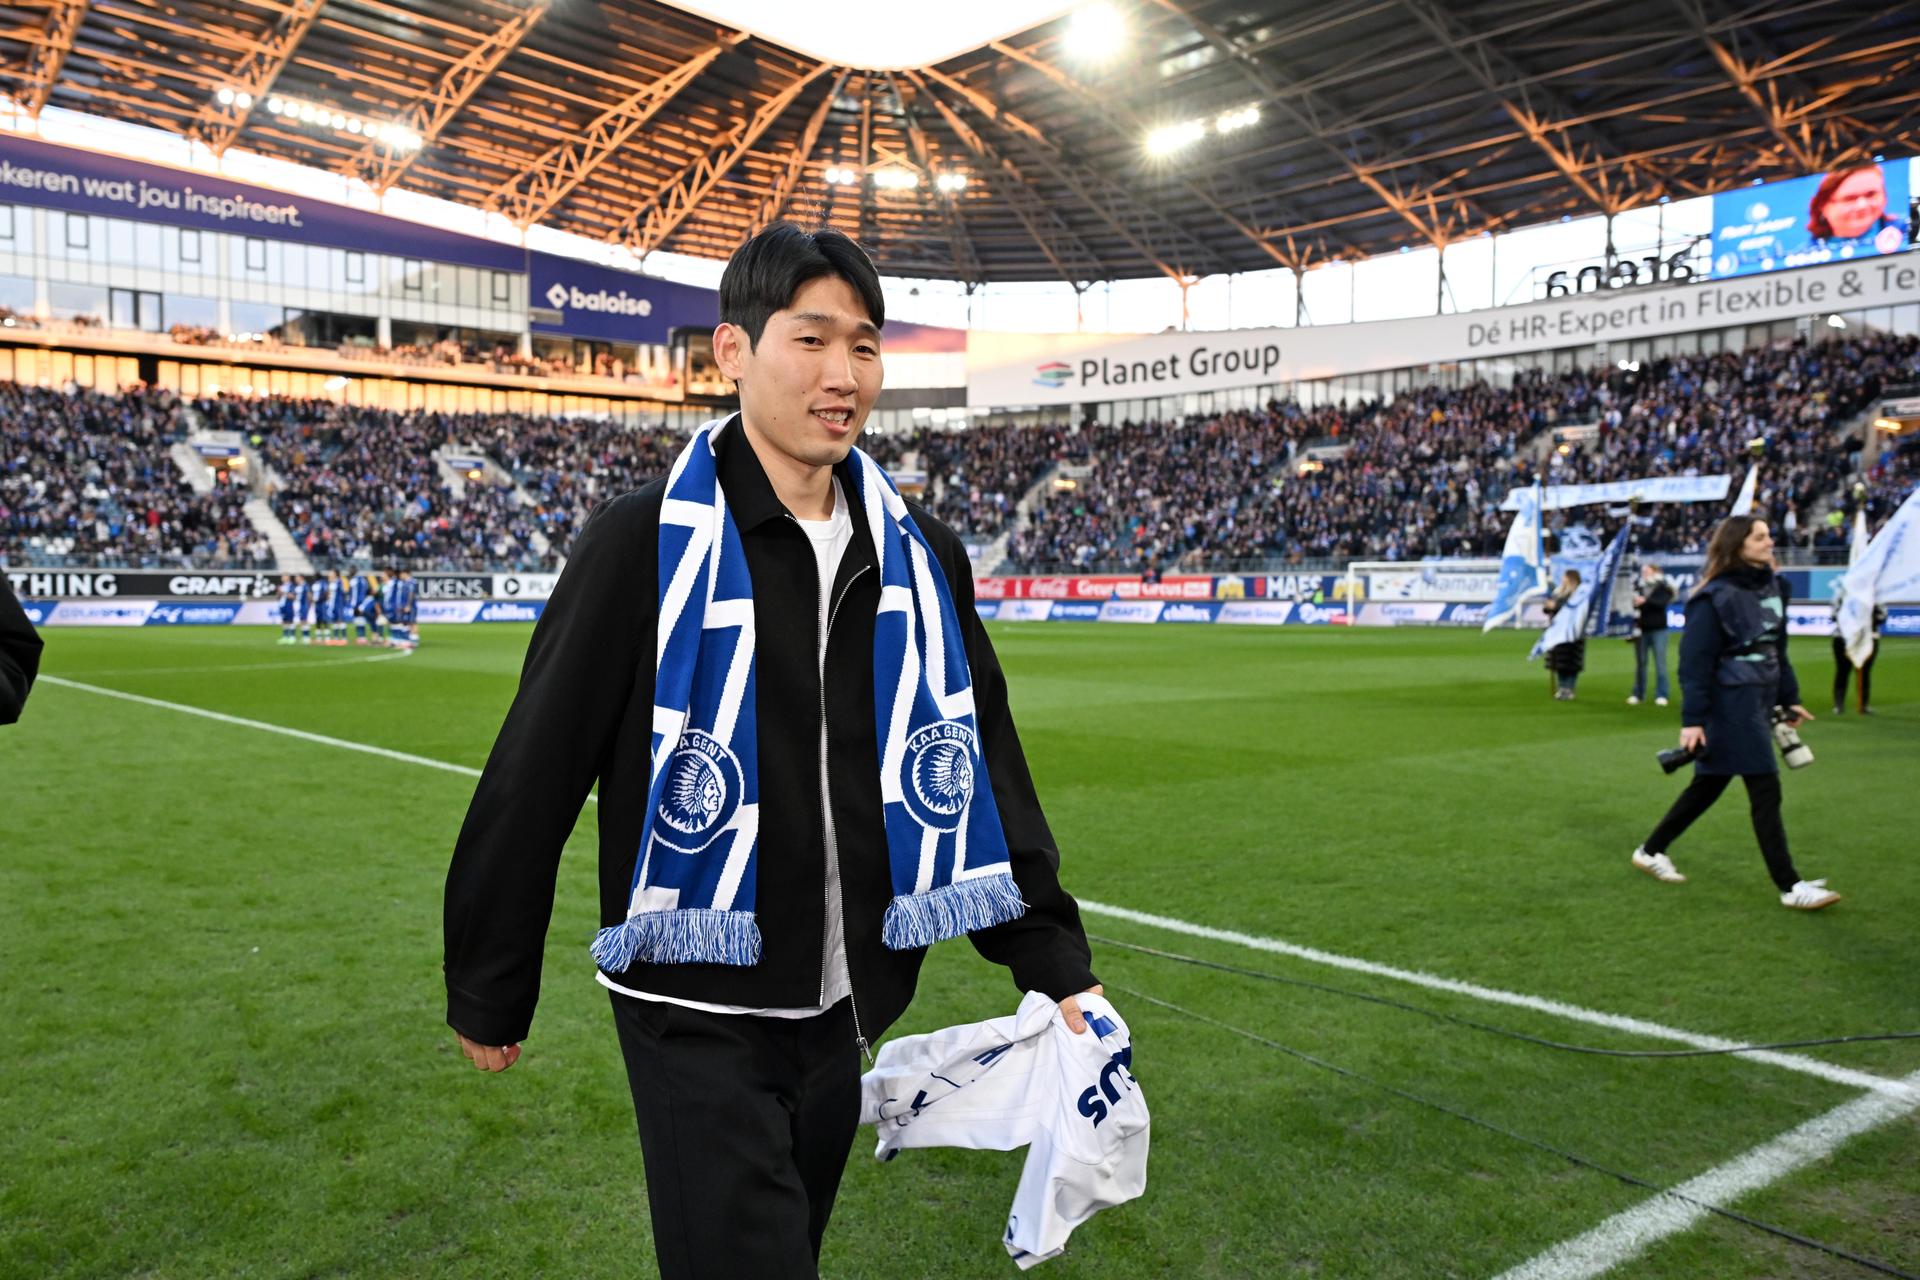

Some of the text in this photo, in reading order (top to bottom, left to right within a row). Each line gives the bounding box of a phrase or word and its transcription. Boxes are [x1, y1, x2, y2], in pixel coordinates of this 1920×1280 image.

[84, 176, 137, 203] wat
[138, 180, 180, 209] jou
[184, 186, 303, 227] inspireert.
[570, 286, 652, 317] baloise
[1468, 263, 1920, 347] Dé HR-Expert in Flexible & Te
[1081, 345, 1280, 387] Planet Group
[8, 573, 118, 597] THING
[169, 576, 253, 595] CRAFT
[418, 578, 483, 598] UKENS
[692, 734, 727, 762] GENT
[909, 725, 974, 752] KAA GENT
